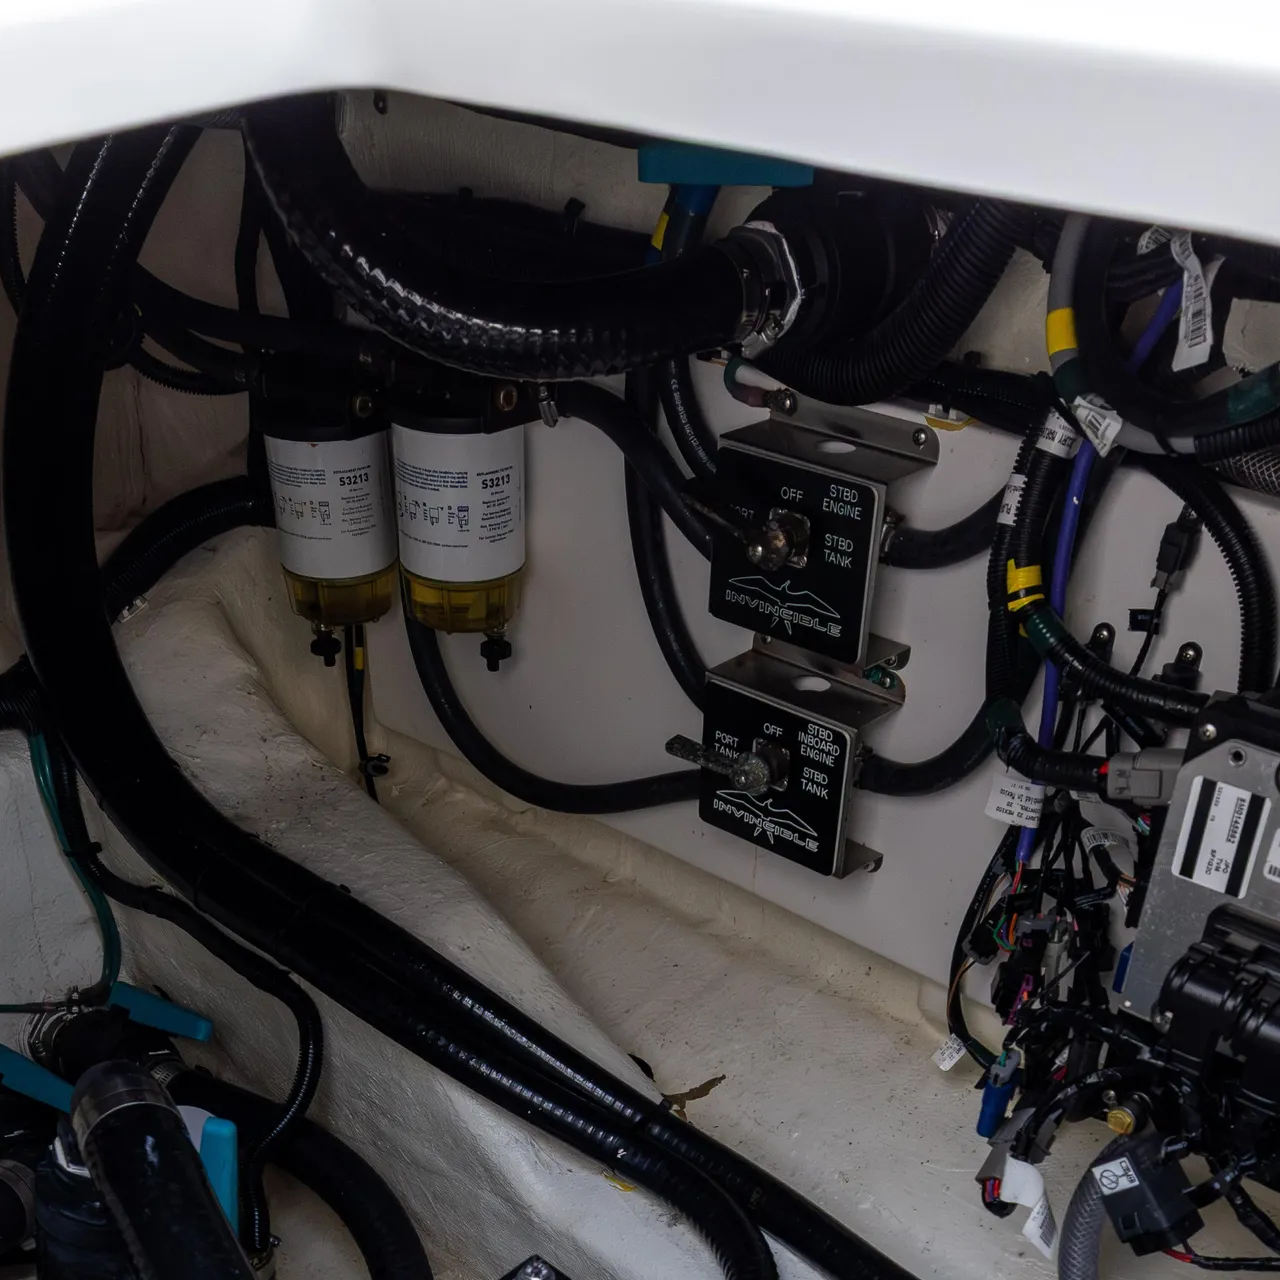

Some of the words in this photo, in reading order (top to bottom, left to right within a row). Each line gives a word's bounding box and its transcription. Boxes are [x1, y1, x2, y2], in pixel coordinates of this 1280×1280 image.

[339, 472, 369, 486] S3213
[481, 473, 510, 489] S3213
[781, 487, 804, 503] OFF
[830, 484, 858, 504] STBD
[729, 504, 755, 520] ORT
[822, 498, 862, 520] ENGINE
[825, 533, 854, 553] STBD
[823, 549, 853, 568] TANK
[726, 589, 842, 638] INVINCIBLE
[715, 730, 739, 748] PORT
[763, 722, 783, 738] OFF
[807, 723, 834, 741] STBD
[714, 742, 740, 759] TANK
[797, 731, 840, 756] INBOARD
[800, 744, 836, 767] ENGINE
[803, 766, 829, 785] STBD
[800, 779, 829, 799] TANK
[995, 805, 1015, 816] MEXICO
[713, 798, 819, 853] INVINCIBLE
